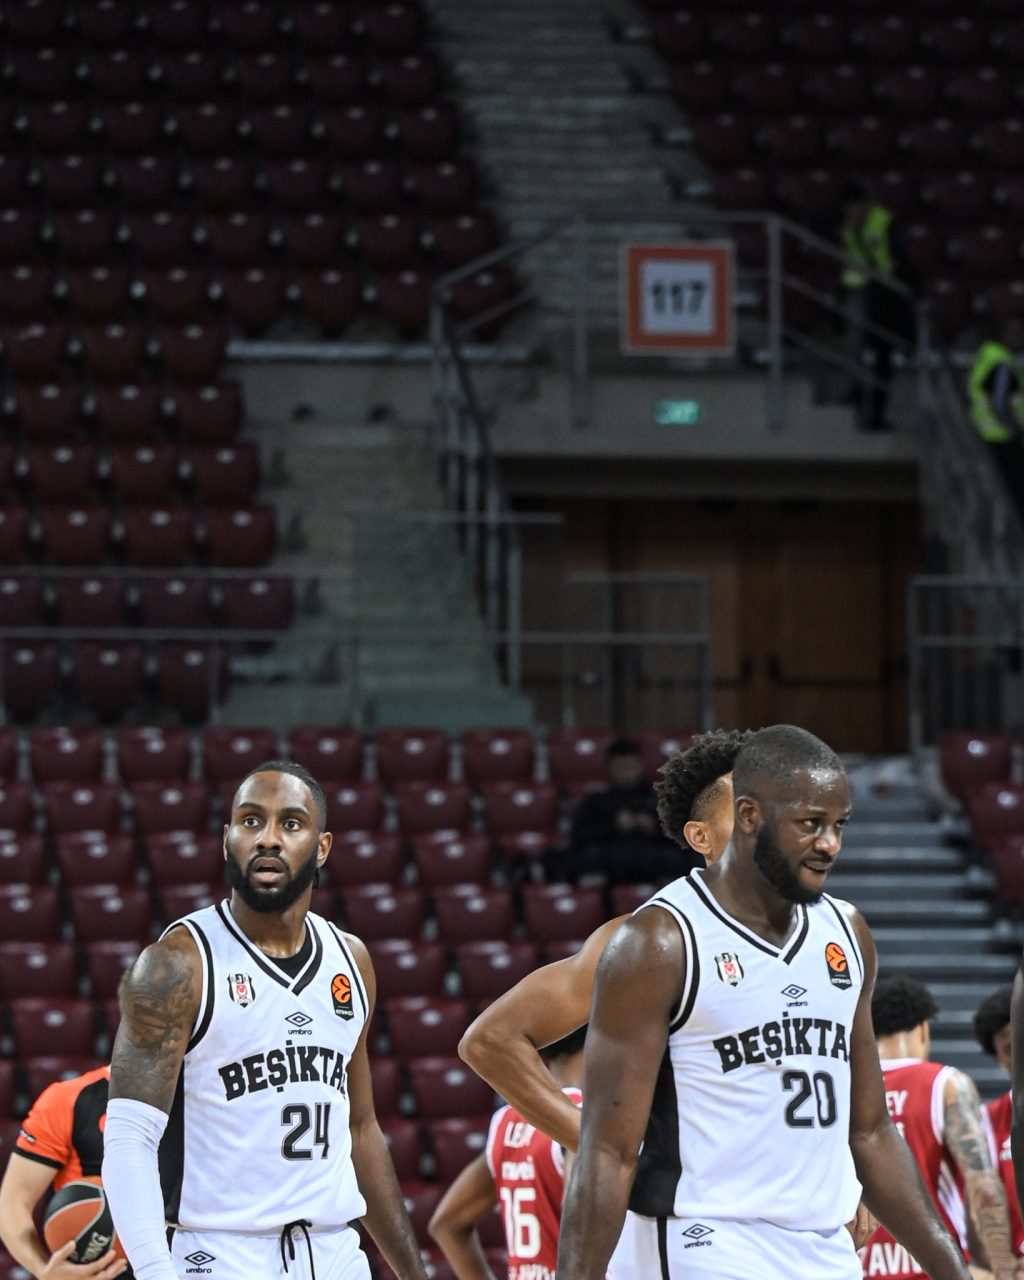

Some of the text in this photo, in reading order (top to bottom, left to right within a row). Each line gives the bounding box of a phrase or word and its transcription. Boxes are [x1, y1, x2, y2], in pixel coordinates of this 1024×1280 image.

[653, 280, 706, 316] 117
[287, 1027, 312, 1036] umbro
[713, 1011, 851, 1073] BEŞİKTA
[782, 1069, 839, 1129] 20
[280, 1102, 331, 1161] 24
[500, 1186, 541, 1259] 16
[684, 1240, 712, 1249] umbro
